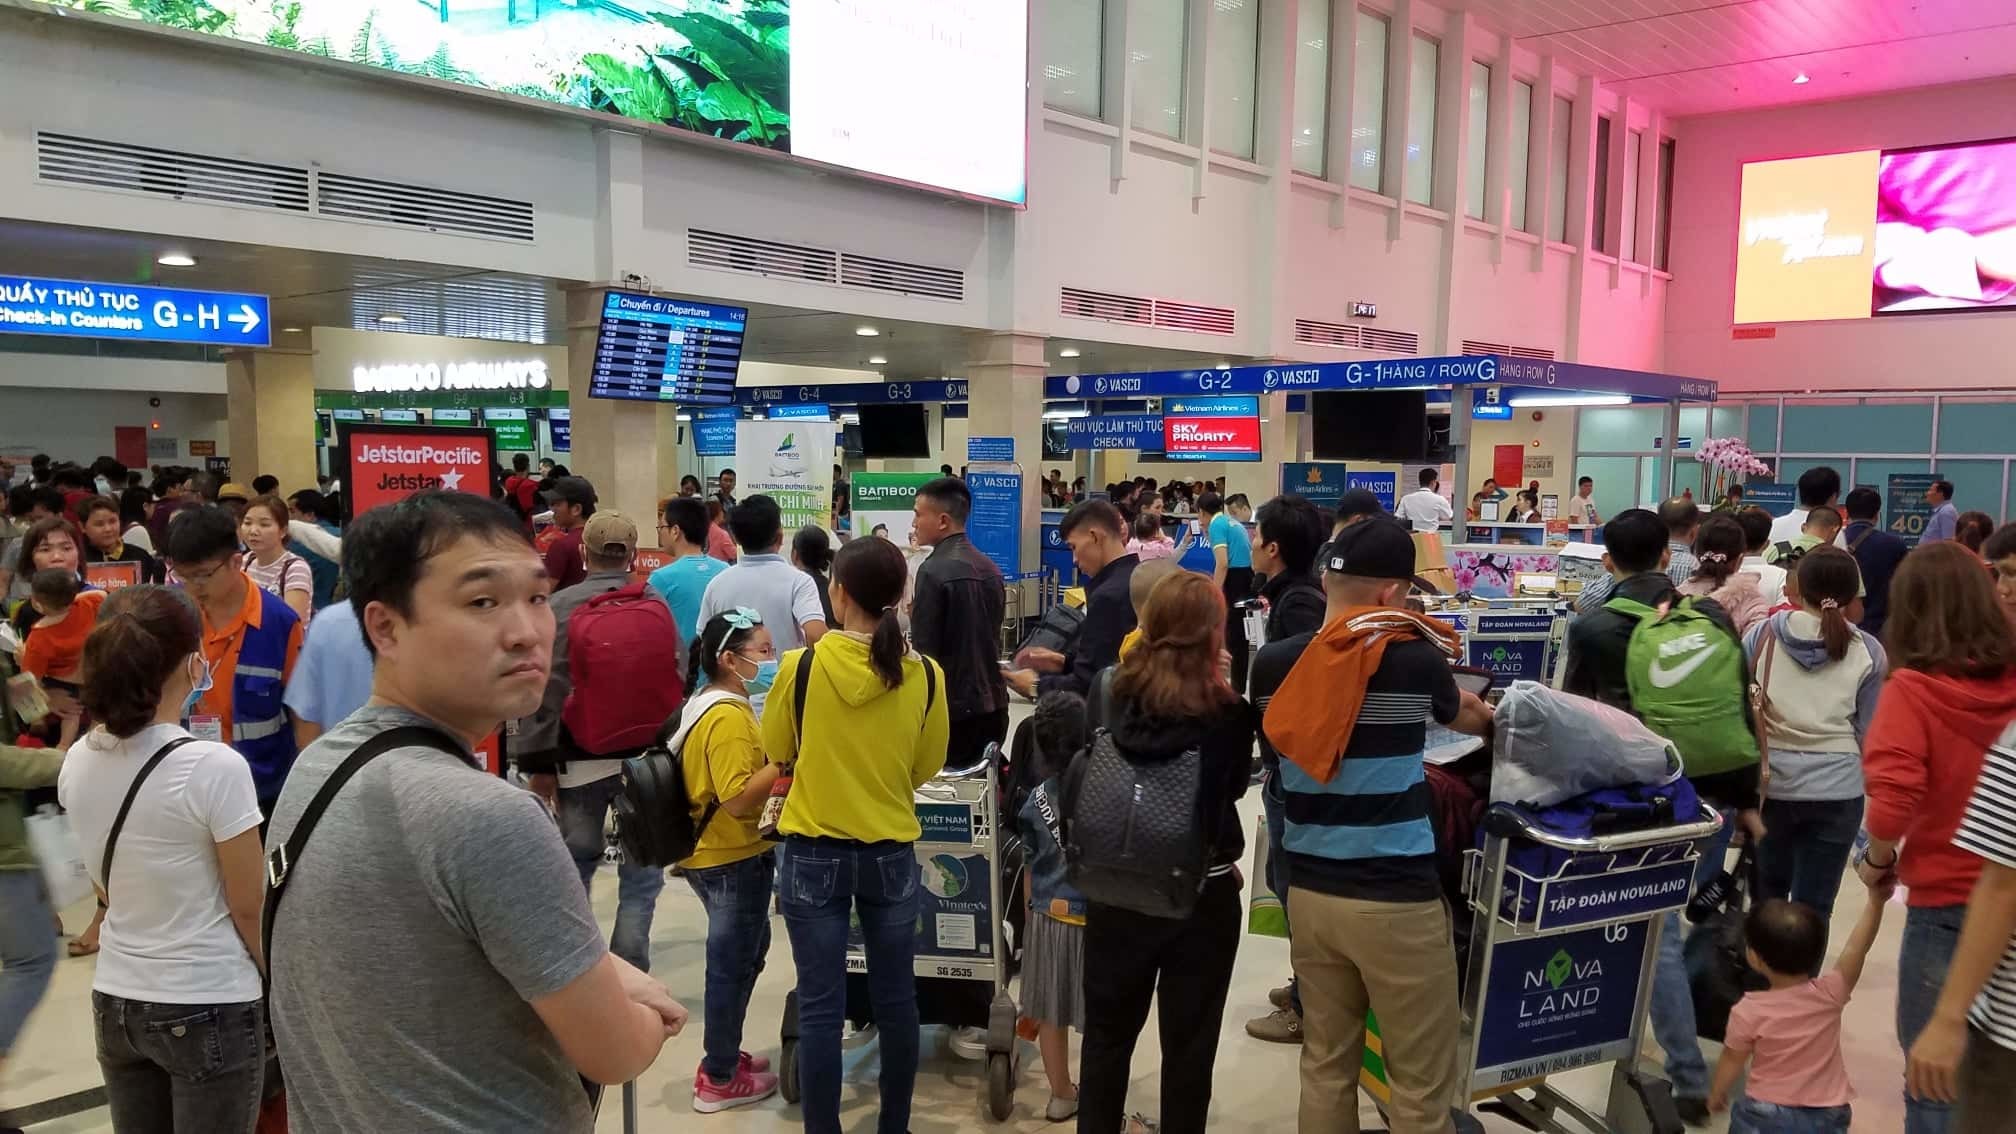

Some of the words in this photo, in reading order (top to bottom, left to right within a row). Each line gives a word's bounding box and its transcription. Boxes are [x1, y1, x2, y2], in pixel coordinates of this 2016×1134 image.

[54, 286, 95, 308] THỦ
[99, 292, 140, 311] TỤC
[668, 303, 711, 319] Departures
[71, 311, 143, 330] Counters
[1282, 370, 1319, 385] VASCO
[1346, 363, 1382, 384] G-1
[1383, 363, 1424, 379] HÀNG
[1440, 364, 1476, 378] ROW
[1477, 359, 1495, 381] G
[1527, 366, 1543, 380] ROW
[1547, 364, 1556, 384] G
[1110, 378, 1140, 393] VASCO
[1199, 372, 1232, 390] G-2
[799, 387, 820, 400] G-4
[888, 384, 912, 399] G-3
[1185, 404, 1213, 413] Vietnam
[1213, 404, 1239, 413] Airlines
[1068, 420, 1085, 433] KHU
[1087, 419, 1104, 435] VỰC
[1106, 418, 1124, 433] LÀM
[1126, 417, 1143, 433] THỦ
[1172, 424, 1199, 434] SKY
[1093, 437, 1123, 449] CHECK
[1126, 437, 1136, 449] IN
[1172, 433, 1235, 442] PRIORITY
[357, 445, 482, 465] JetstarPacific
[377, 472, 442, 490] Jetstar
[984, 477, 1018, 488] VASCO
[1361, 481, 1393, 495] VASCO
[859, 486, 918, 497] BAMBOO
[924, 814, 944, 826] VIỆT
[946, 816, 968, 825] NAM
[1549, 896, 1576, 913] TẬP
[1579, 889, 1617, 908] ĐOÀN
[1619, 879, 1686, 901] NOVALAND
[937, 966, 949, 976] SG
[951, 967, 972, 977] 2535
[1519, 987, 1600, 1018] LAND
